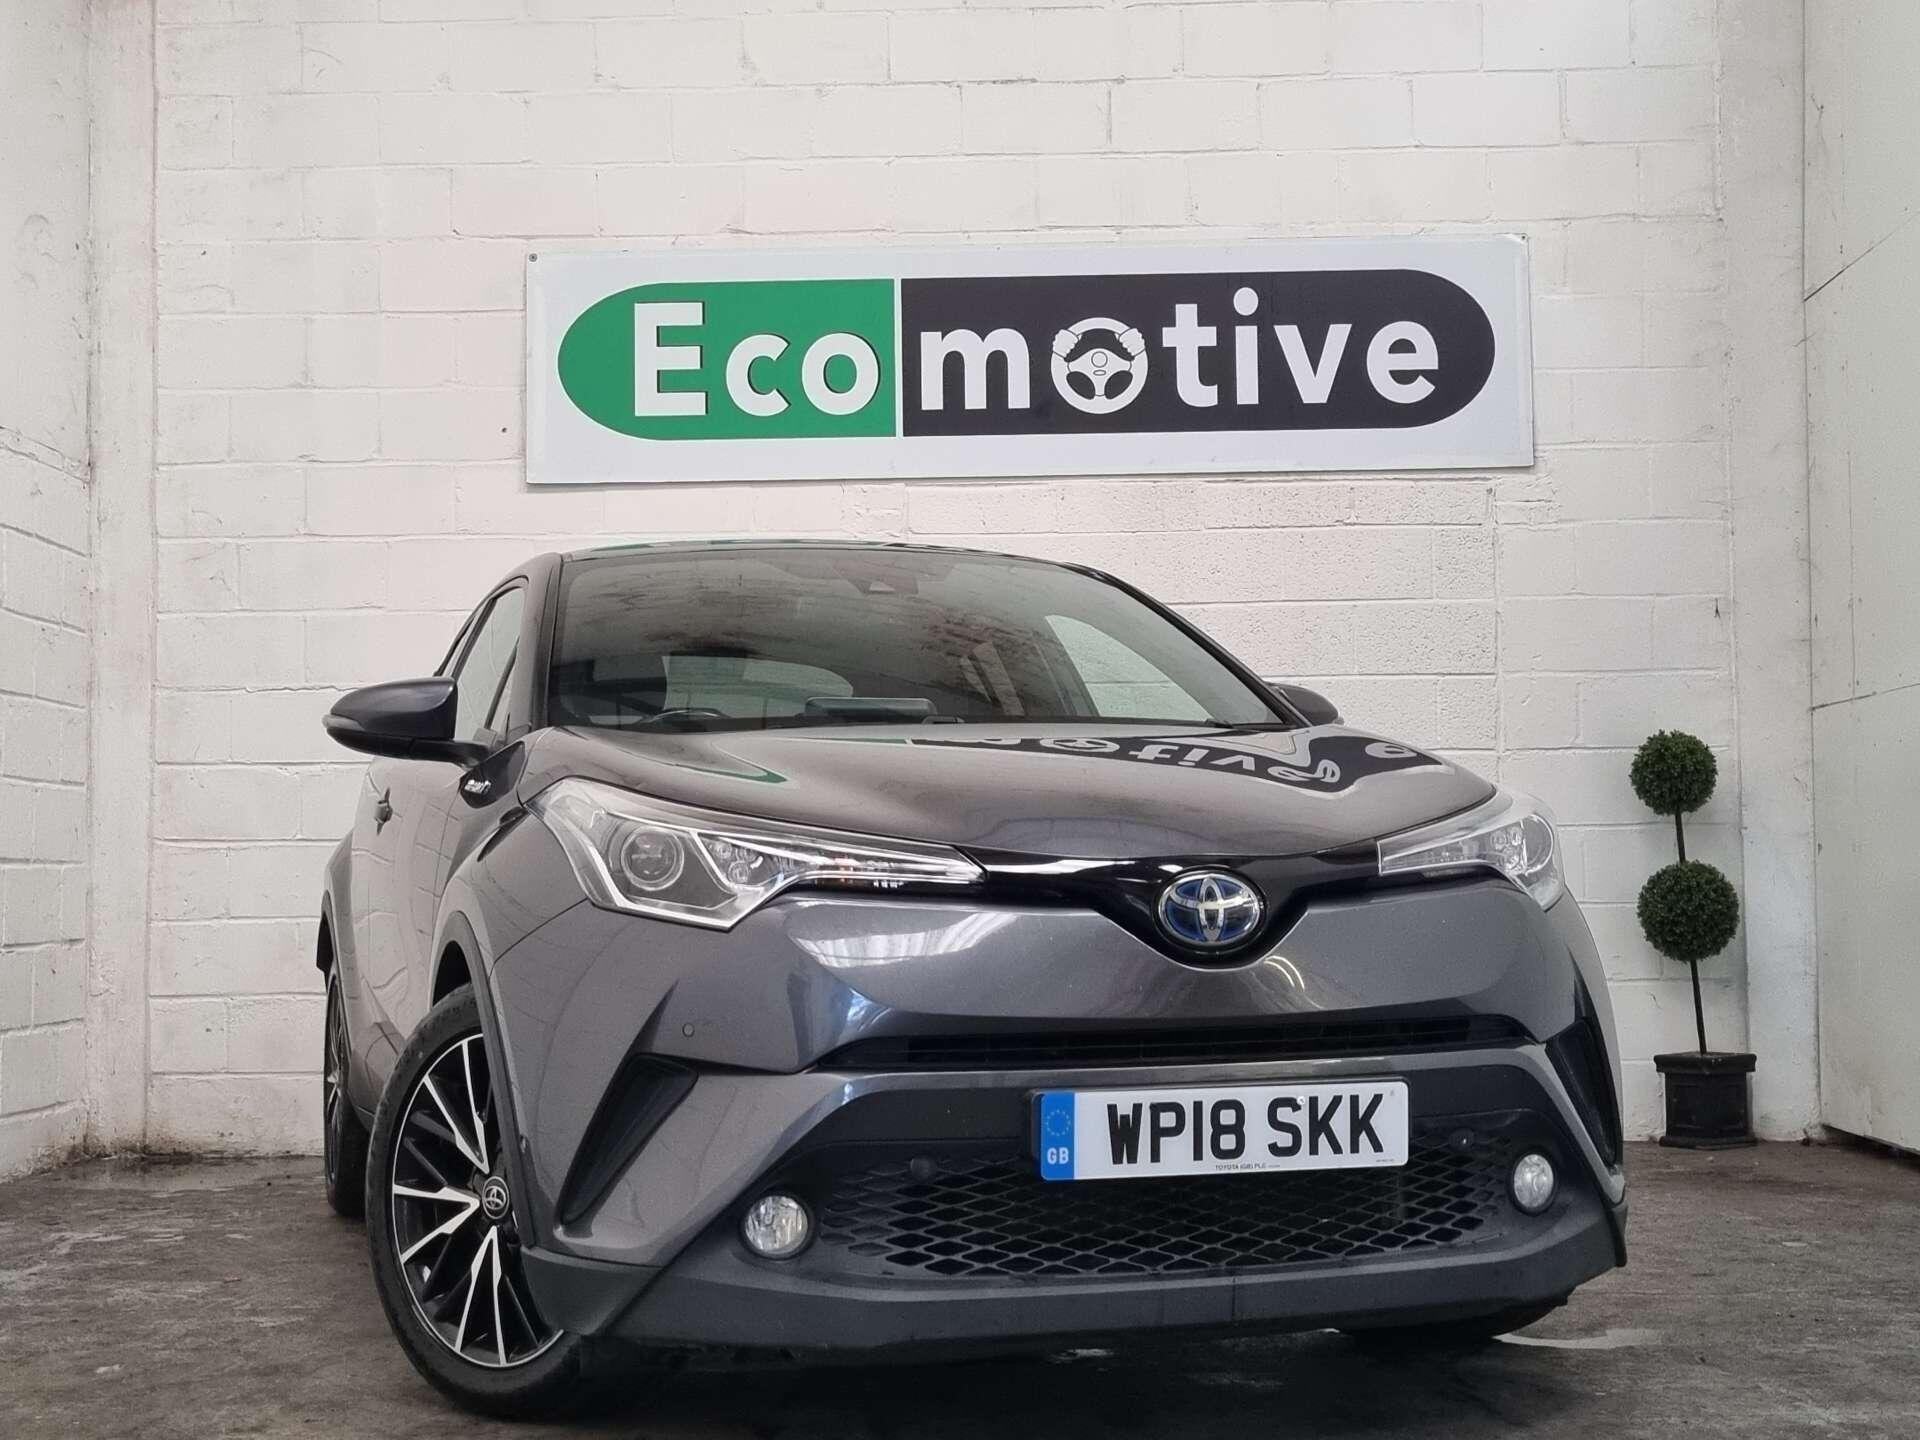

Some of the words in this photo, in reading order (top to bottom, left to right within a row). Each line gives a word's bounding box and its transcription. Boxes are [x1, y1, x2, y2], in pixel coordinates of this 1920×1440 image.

[634, 287, 1439, 416] Ecomotive
[1047, 1147, 1069, 1165] GB
[1107, 1099, 1246, 1165] WP18
[1267, 1093, 1384, 1158] SKK
